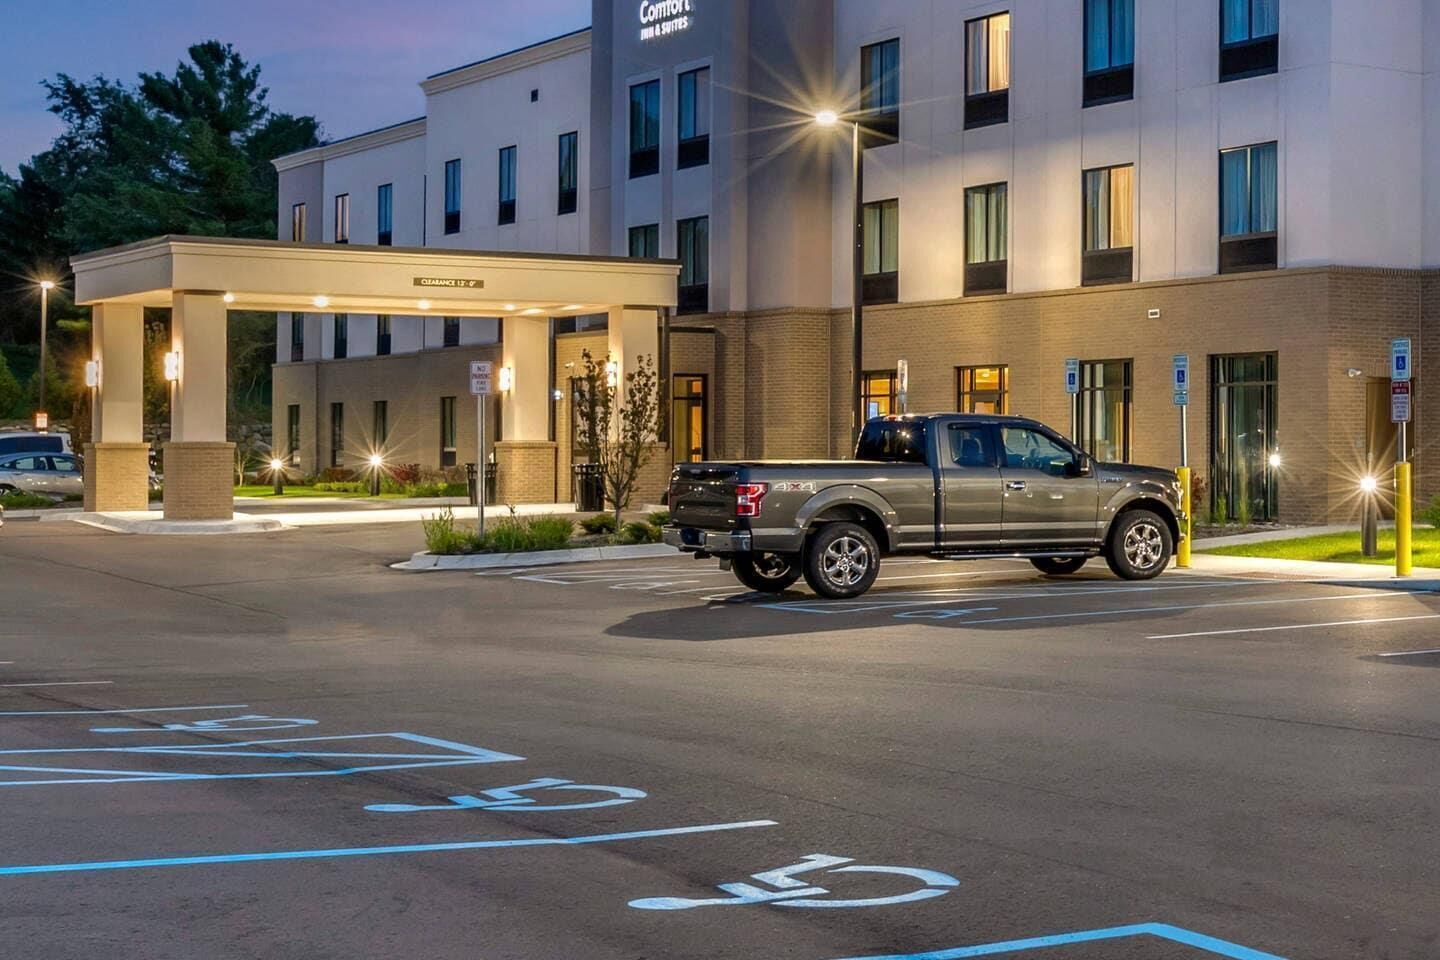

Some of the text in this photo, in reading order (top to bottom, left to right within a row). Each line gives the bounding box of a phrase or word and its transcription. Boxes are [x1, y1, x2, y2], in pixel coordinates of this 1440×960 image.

[641, 26, 654, 40] INN
[661, 15, 688, 35] SUITES
[421, 278, 455, 287] CLEARANCE
